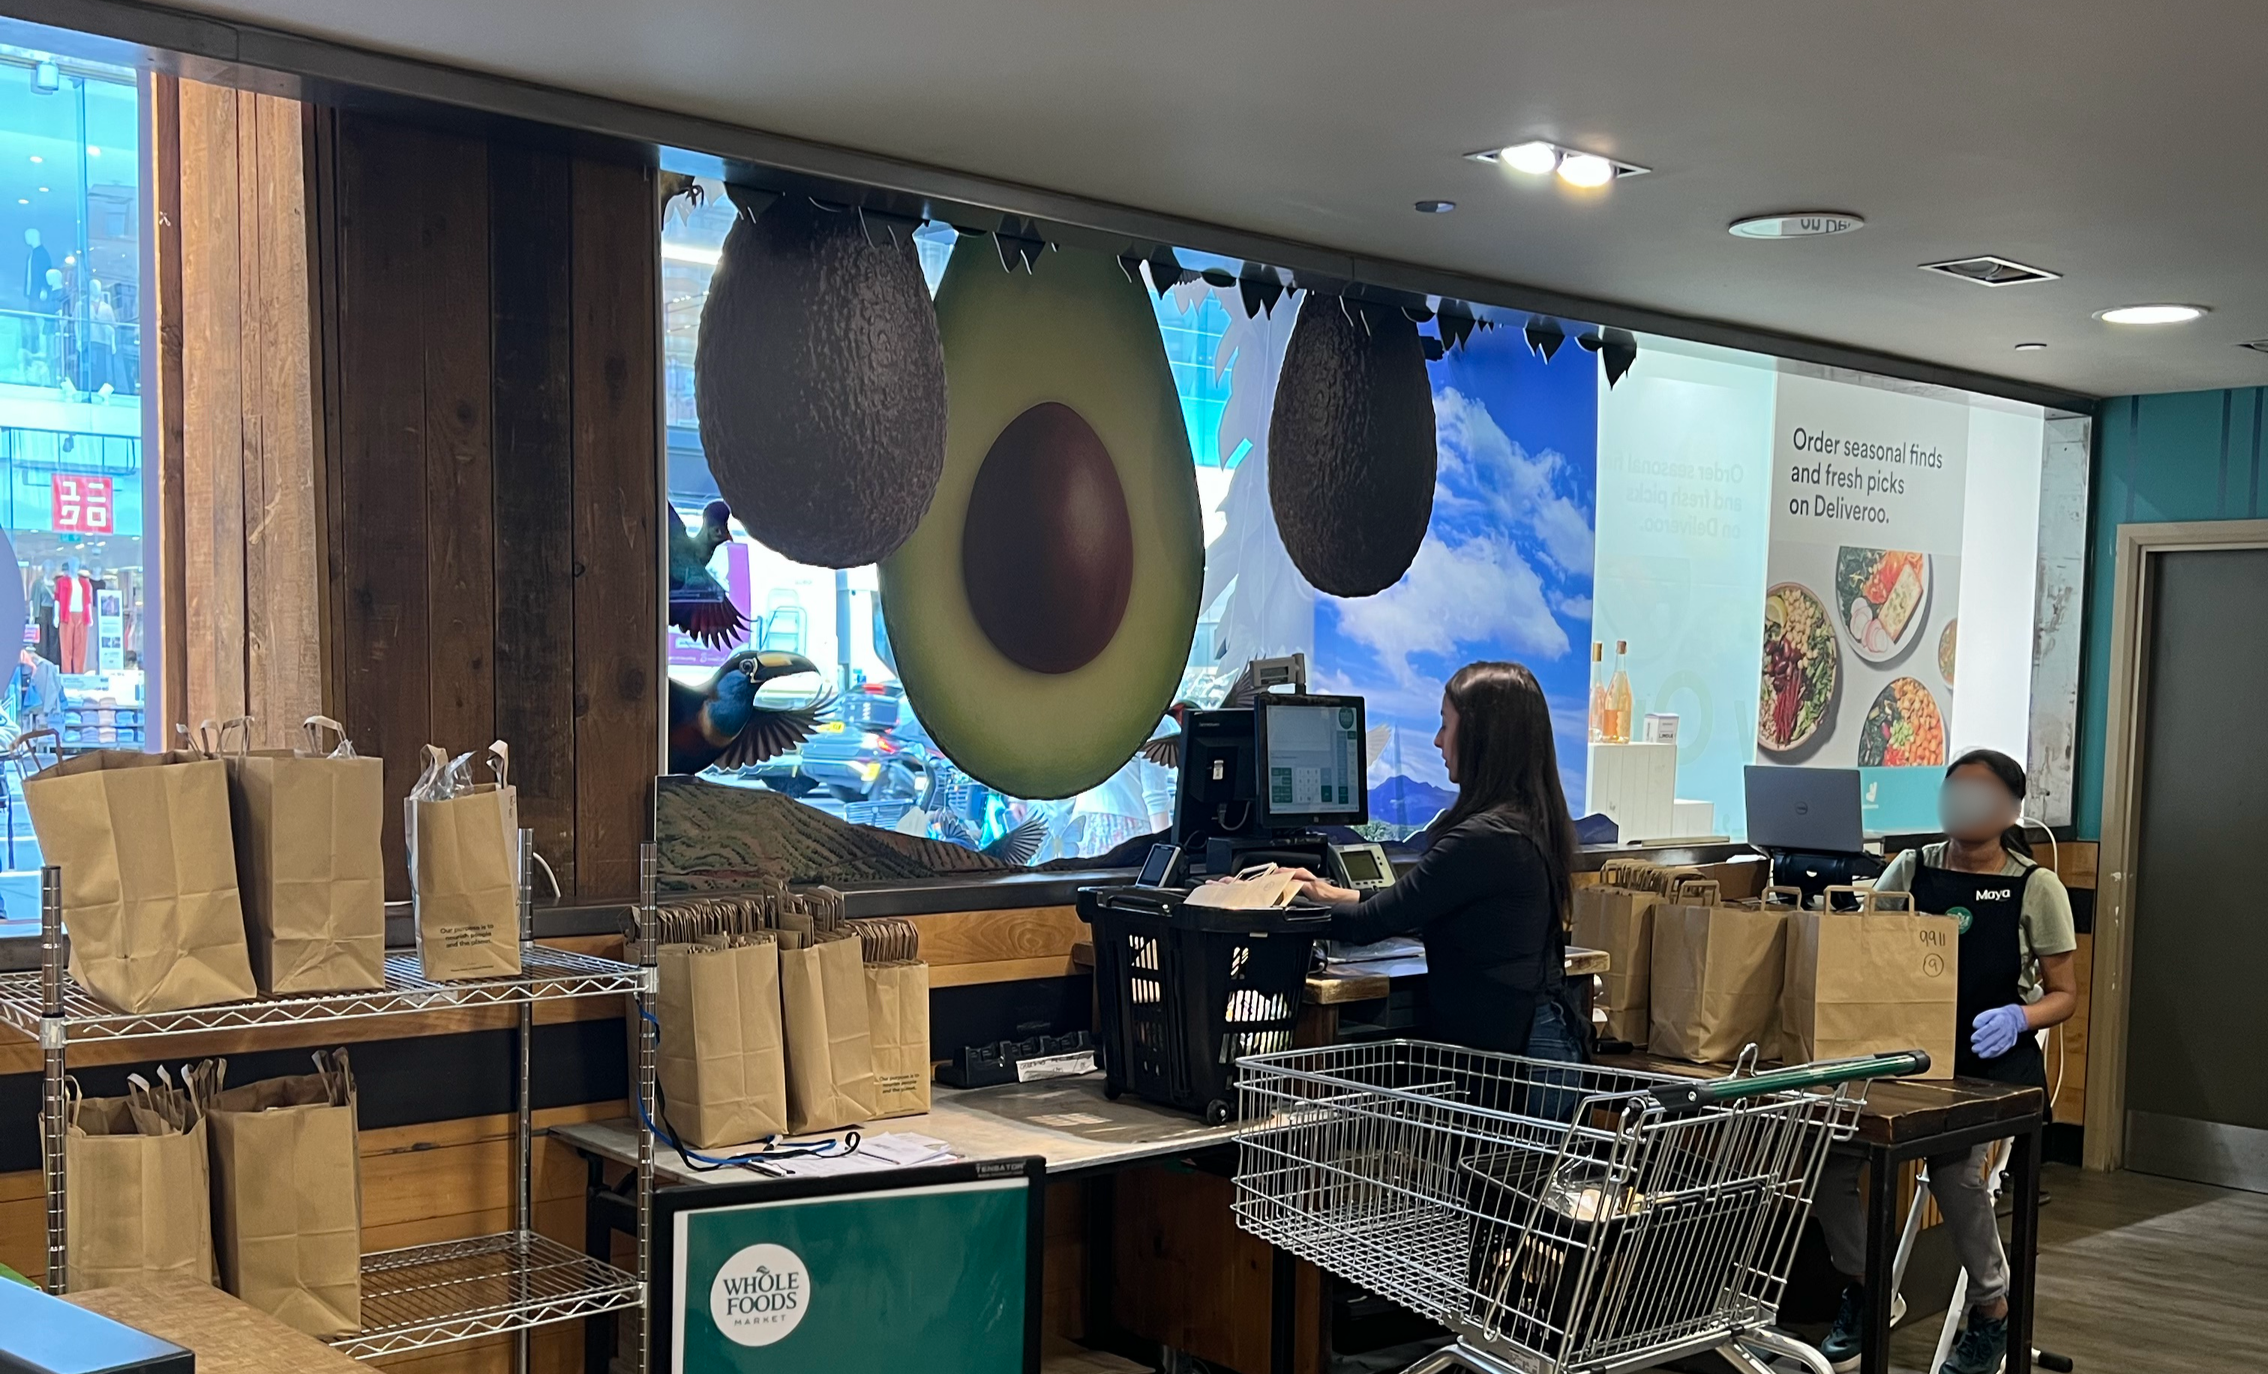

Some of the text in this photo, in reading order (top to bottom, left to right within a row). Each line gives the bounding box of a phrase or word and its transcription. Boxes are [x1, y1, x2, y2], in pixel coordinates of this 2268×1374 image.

[1793, 427, 1943, 469] Order seasonal finds
[1791, 462, 1905, 496] and fresh picks
[1789, 494, 1890, 524] on Deliveroo.
[1976, 889, 2011, 901] Maya
[446, 940, 459, 948] and
[1919, 930, 1946, 947] 9911
[723, 1270, 799, 1296] WHOLE
[726, 1291, 797, 1316] FOODS
[734, 1314, 787, 1327] MARKET
